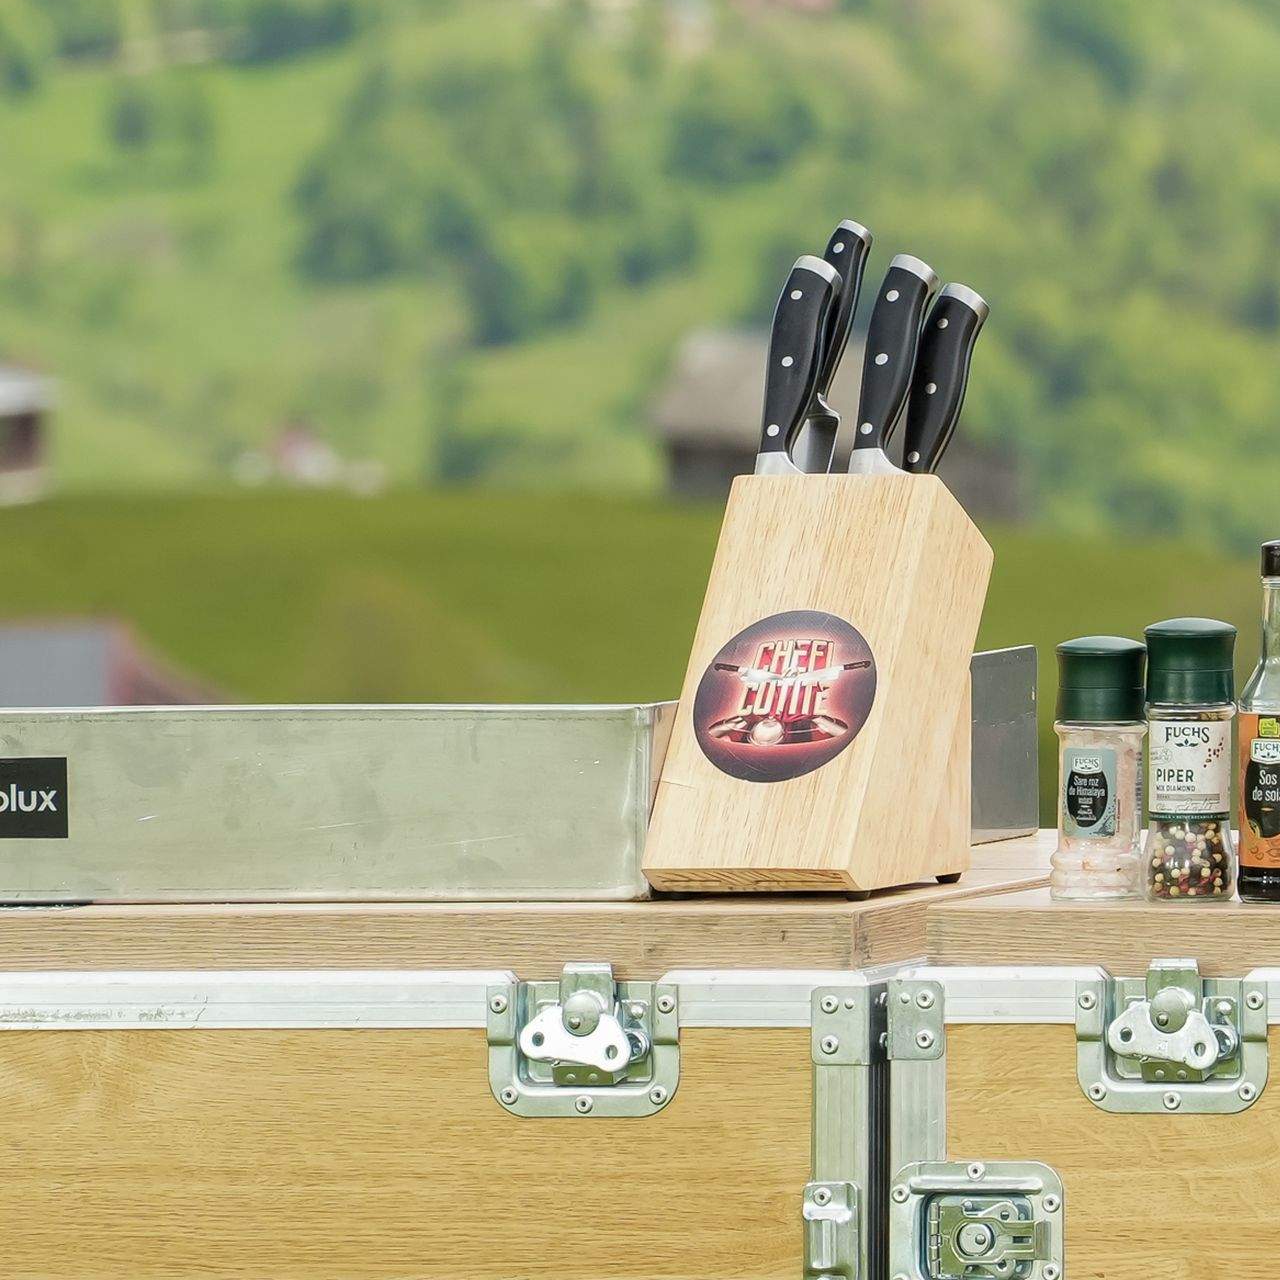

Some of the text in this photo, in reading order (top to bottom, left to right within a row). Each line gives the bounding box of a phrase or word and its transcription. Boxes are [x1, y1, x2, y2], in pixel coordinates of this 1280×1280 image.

[1164, 726, 1210, 744] FUCHS
[1073, 758, 1099, 769] FUCHS
[1156, 768, 1194, 783] PIPER
[1258, 769, 1278, 786] Sos
[1252, 786, 1263, 802] de
